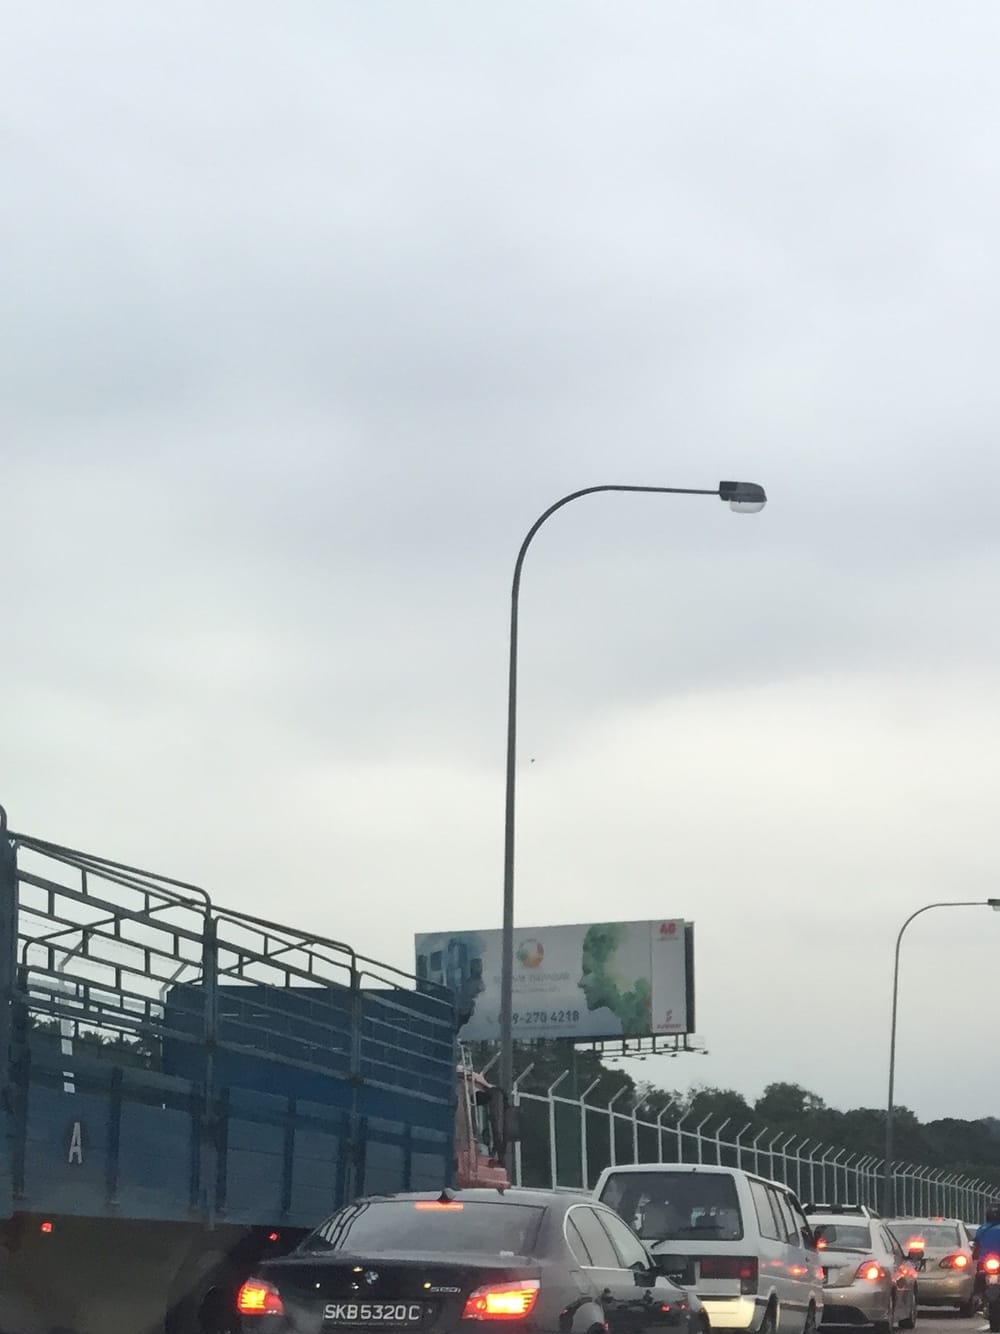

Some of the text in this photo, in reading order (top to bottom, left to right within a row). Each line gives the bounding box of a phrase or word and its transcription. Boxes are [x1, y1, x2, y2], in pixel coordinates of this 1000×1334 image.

[498, 1010, 580, 1025] 09-270 4218
[68, 1121, 83, 1164] A
[324, 1304, 421, 1320] SKB5320C
